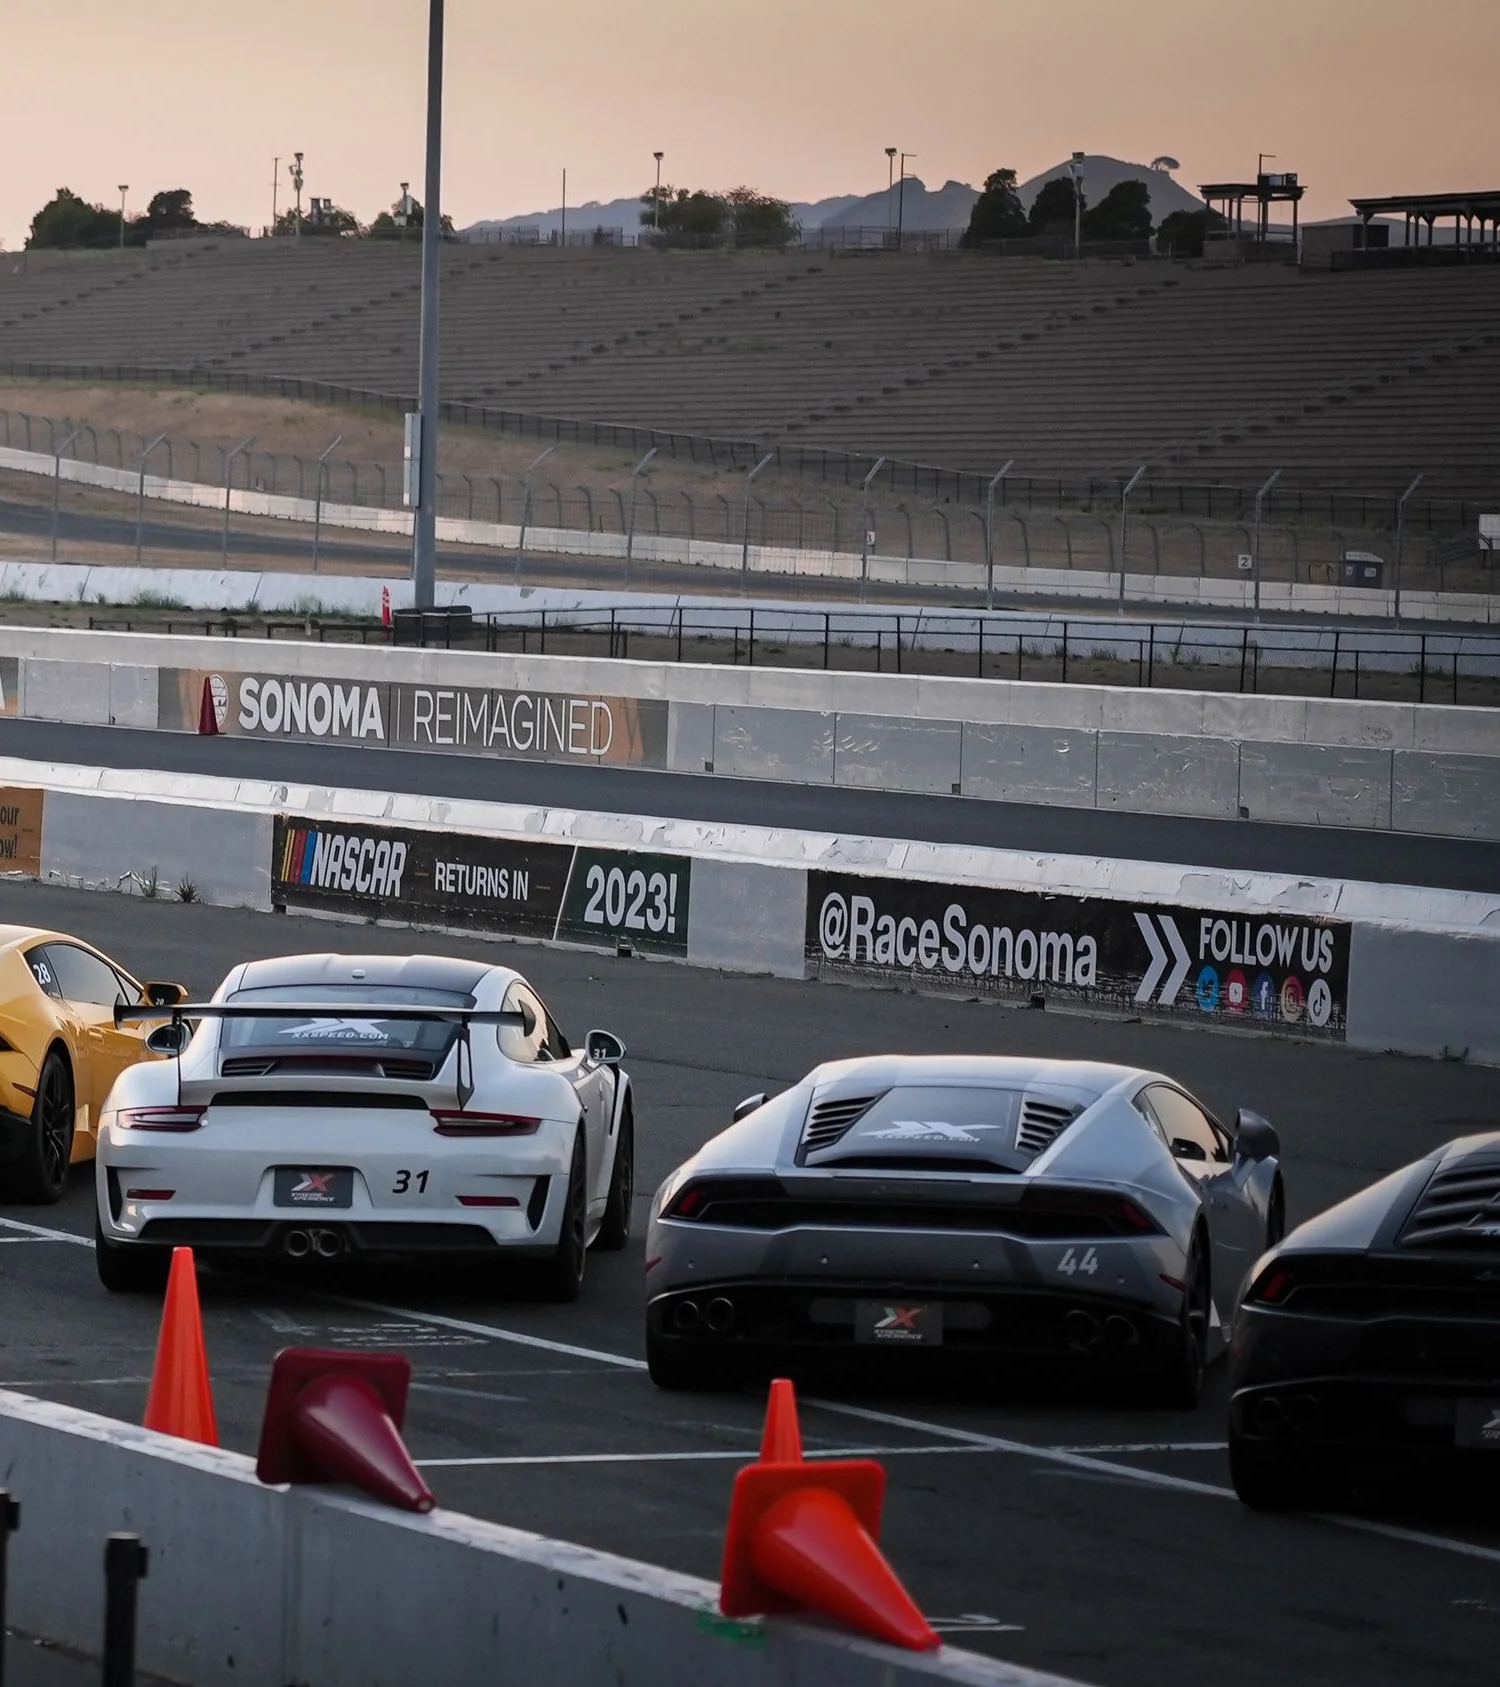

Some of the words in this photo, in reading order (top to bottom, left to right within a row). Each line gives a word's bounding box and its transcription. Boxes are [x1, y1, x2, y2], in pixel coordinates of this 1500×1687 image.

[1241, 557, 1248, 567] 2
[238, 676, 385, 740] SONOMA
[413, 689, 613, 756] REIMAGINED
[309, 831, 408, 898] NASCAR
[434, 861, 509, 899] RETURNS
[512, 870, 529, 901] IN
[583, 864, 678, 934] 2023!
[819, 891, 1098, 987] @RaceSonoma
[1198, 917, 1299, 968] FOLLOW
[1301, 927, 1334, 975] US
[33, 963, 51, 985] 28
[292, 1031, 389, 1040] XXSPEED.COM
[593, 1048, 607, 1059] 31
[392, 1169, 430, 1194] 31
[1057, 1247, 1099, 1276] 44
